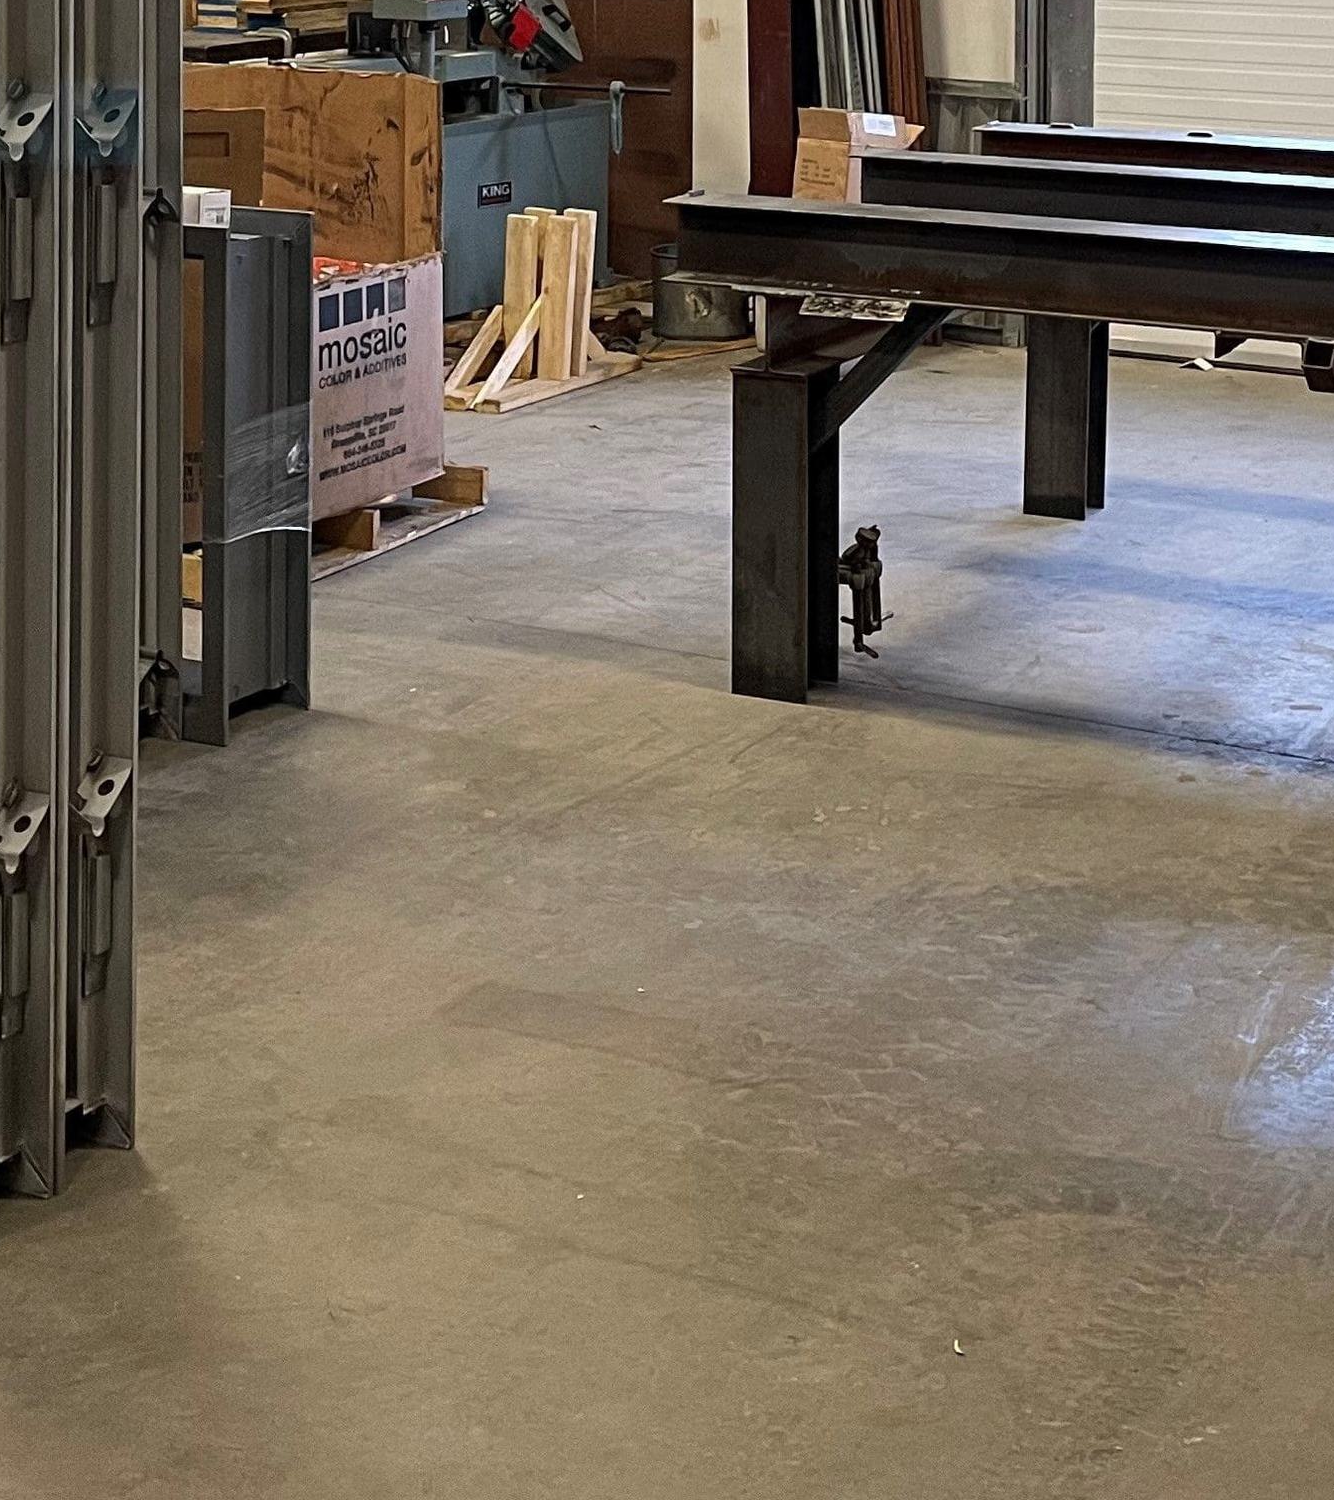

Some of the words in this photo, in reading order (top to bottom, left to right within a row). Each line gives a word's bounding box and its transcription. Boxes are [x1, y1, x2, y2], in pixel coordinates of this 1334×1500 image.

[482, 184, 510, 198] KING
[318, 316, 407, 372] mosaic
[318, 369, 353, 390] COLOR
[362, 352, 407, 377] ADDITIVES
